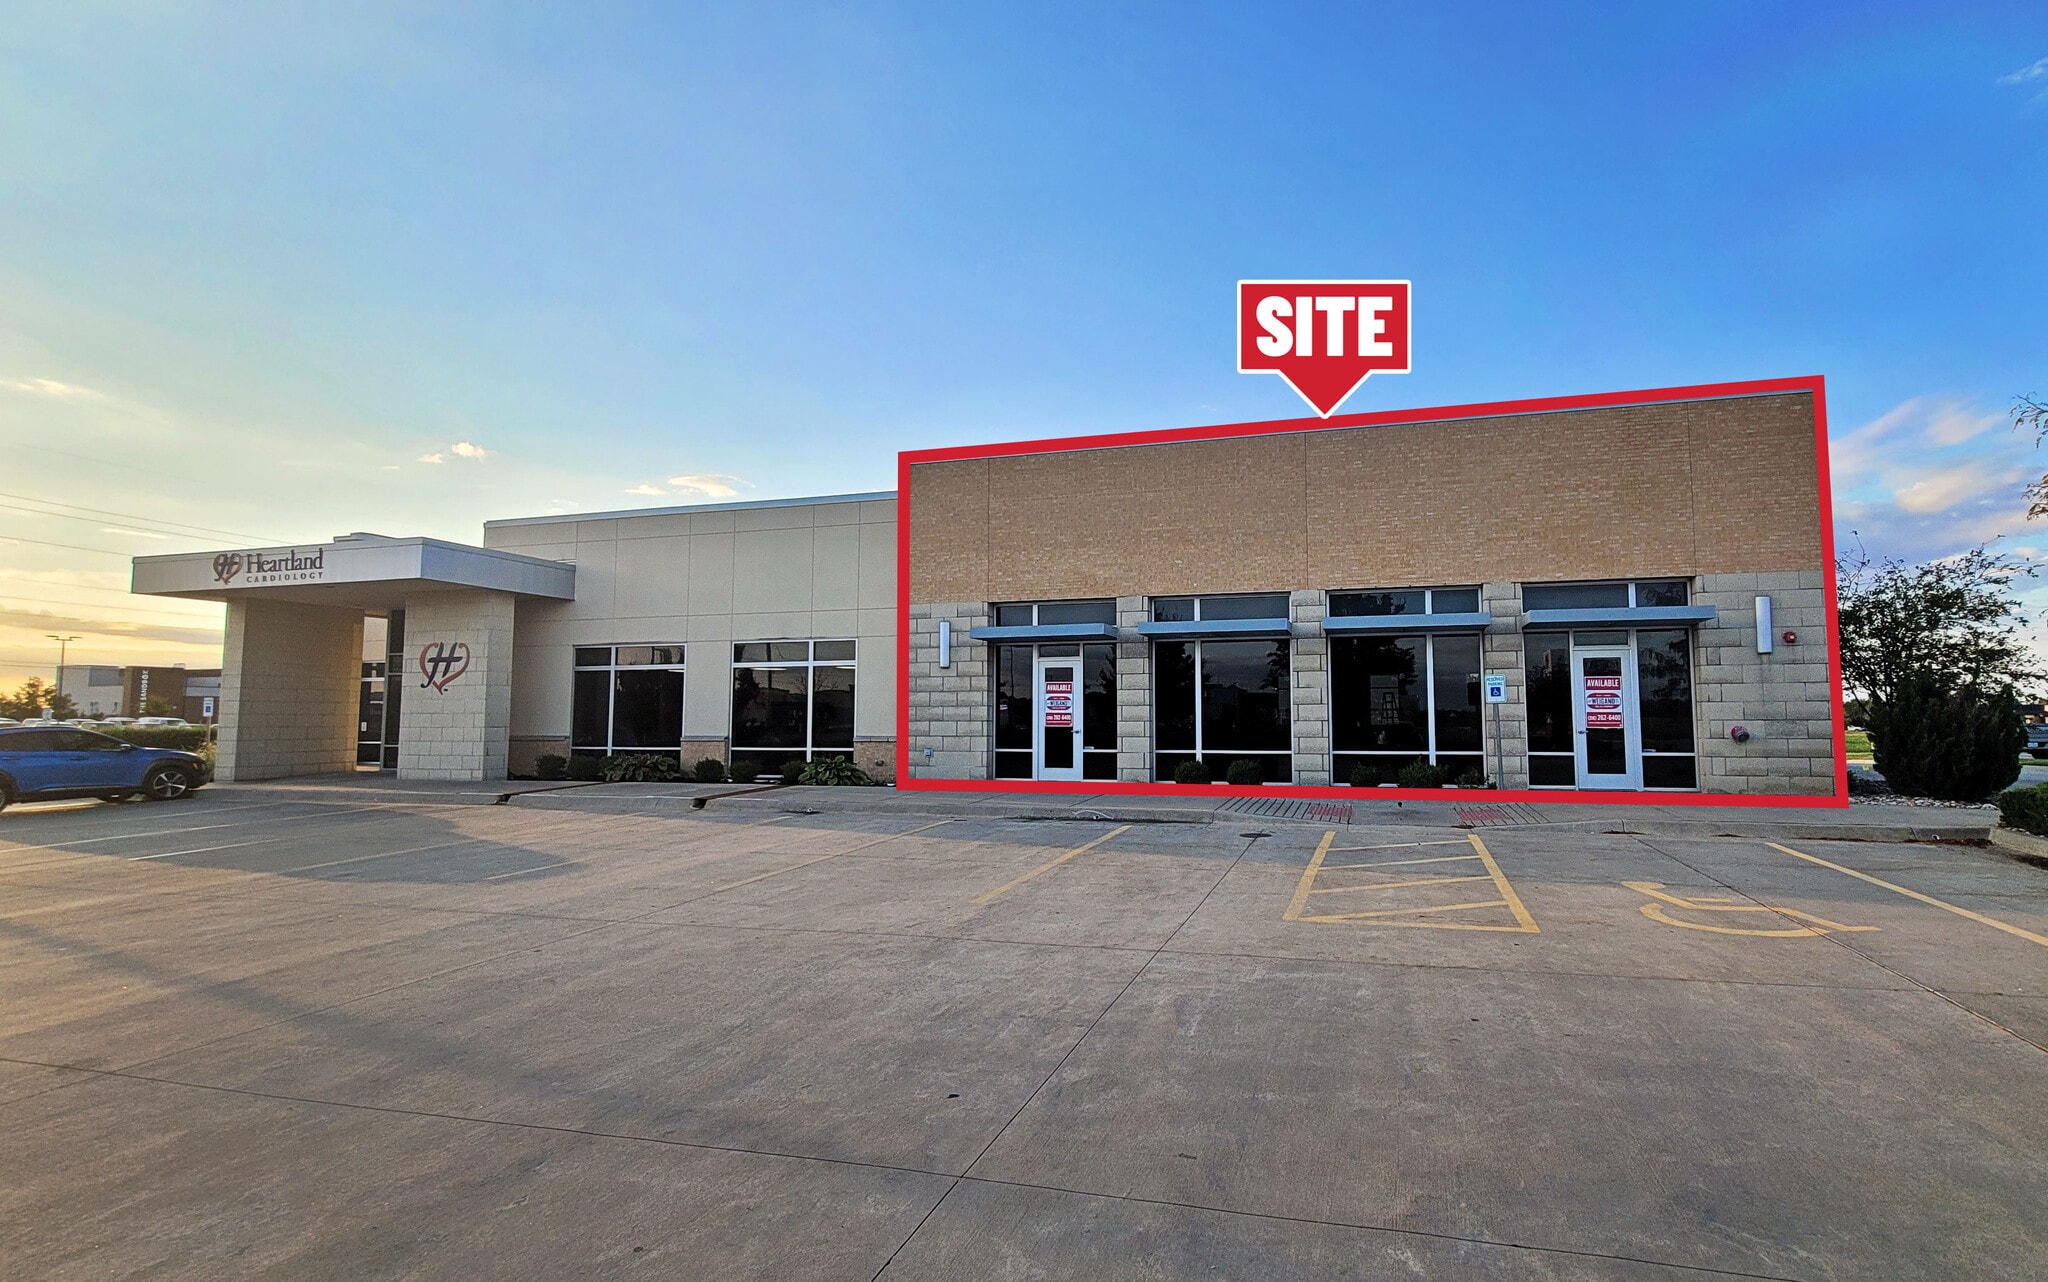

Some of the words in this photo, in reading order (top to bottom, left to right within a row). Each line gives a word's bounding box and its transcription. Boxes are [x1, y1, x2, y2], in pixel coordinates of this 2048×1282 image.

[246, 547, 324, 574] Heartland
[246, 571, 323, 583] CARDIOLOGY
[140, 669, 149, 701] SANDBOX
[1046, 684, 1072, 692] AVAILABLE
[1586, 679, 1620, 688] AVAILABLE
